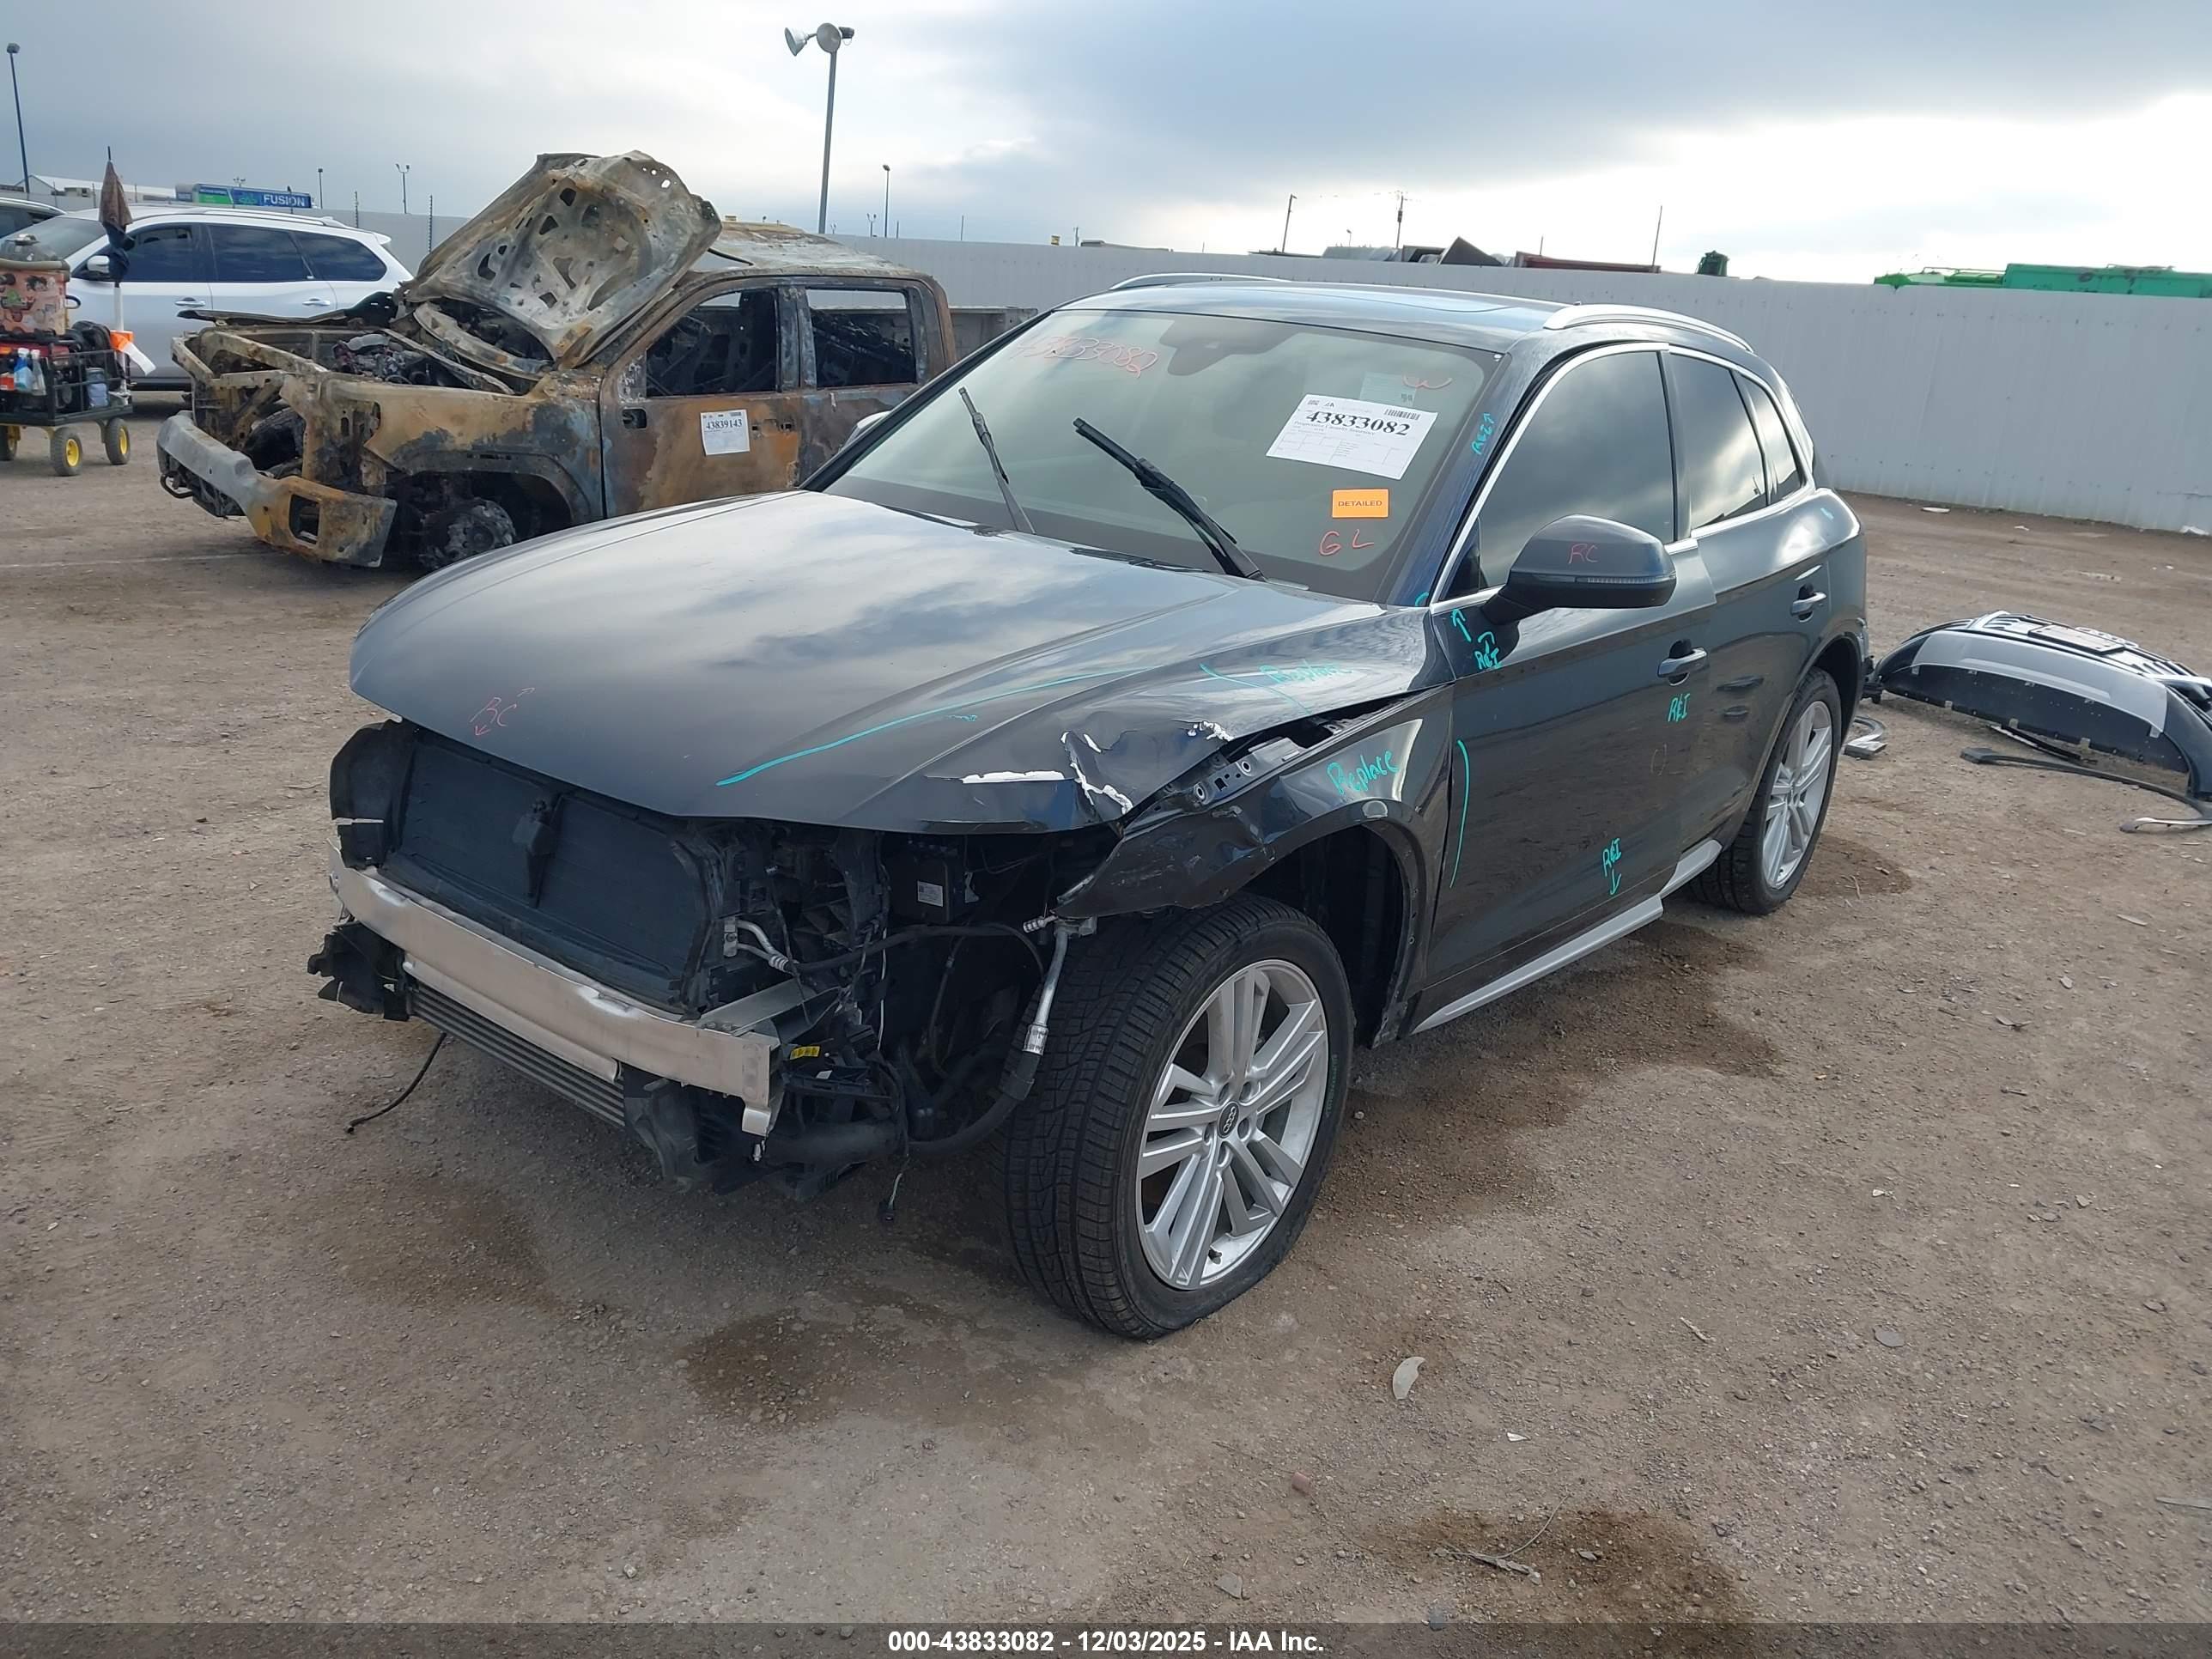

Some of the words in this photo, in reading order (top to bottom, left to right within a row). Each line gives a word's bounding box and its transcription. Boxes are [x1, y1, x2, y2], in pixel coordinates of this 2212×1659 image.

[263, 193, 306, 207] FUSION
[706, 418, 743, 429] 43839143
[1305, 410, 1411, 436] 43833082
[1568, 542, 1599, 564] RC
[1327, 750, 1401, 796] Replace
